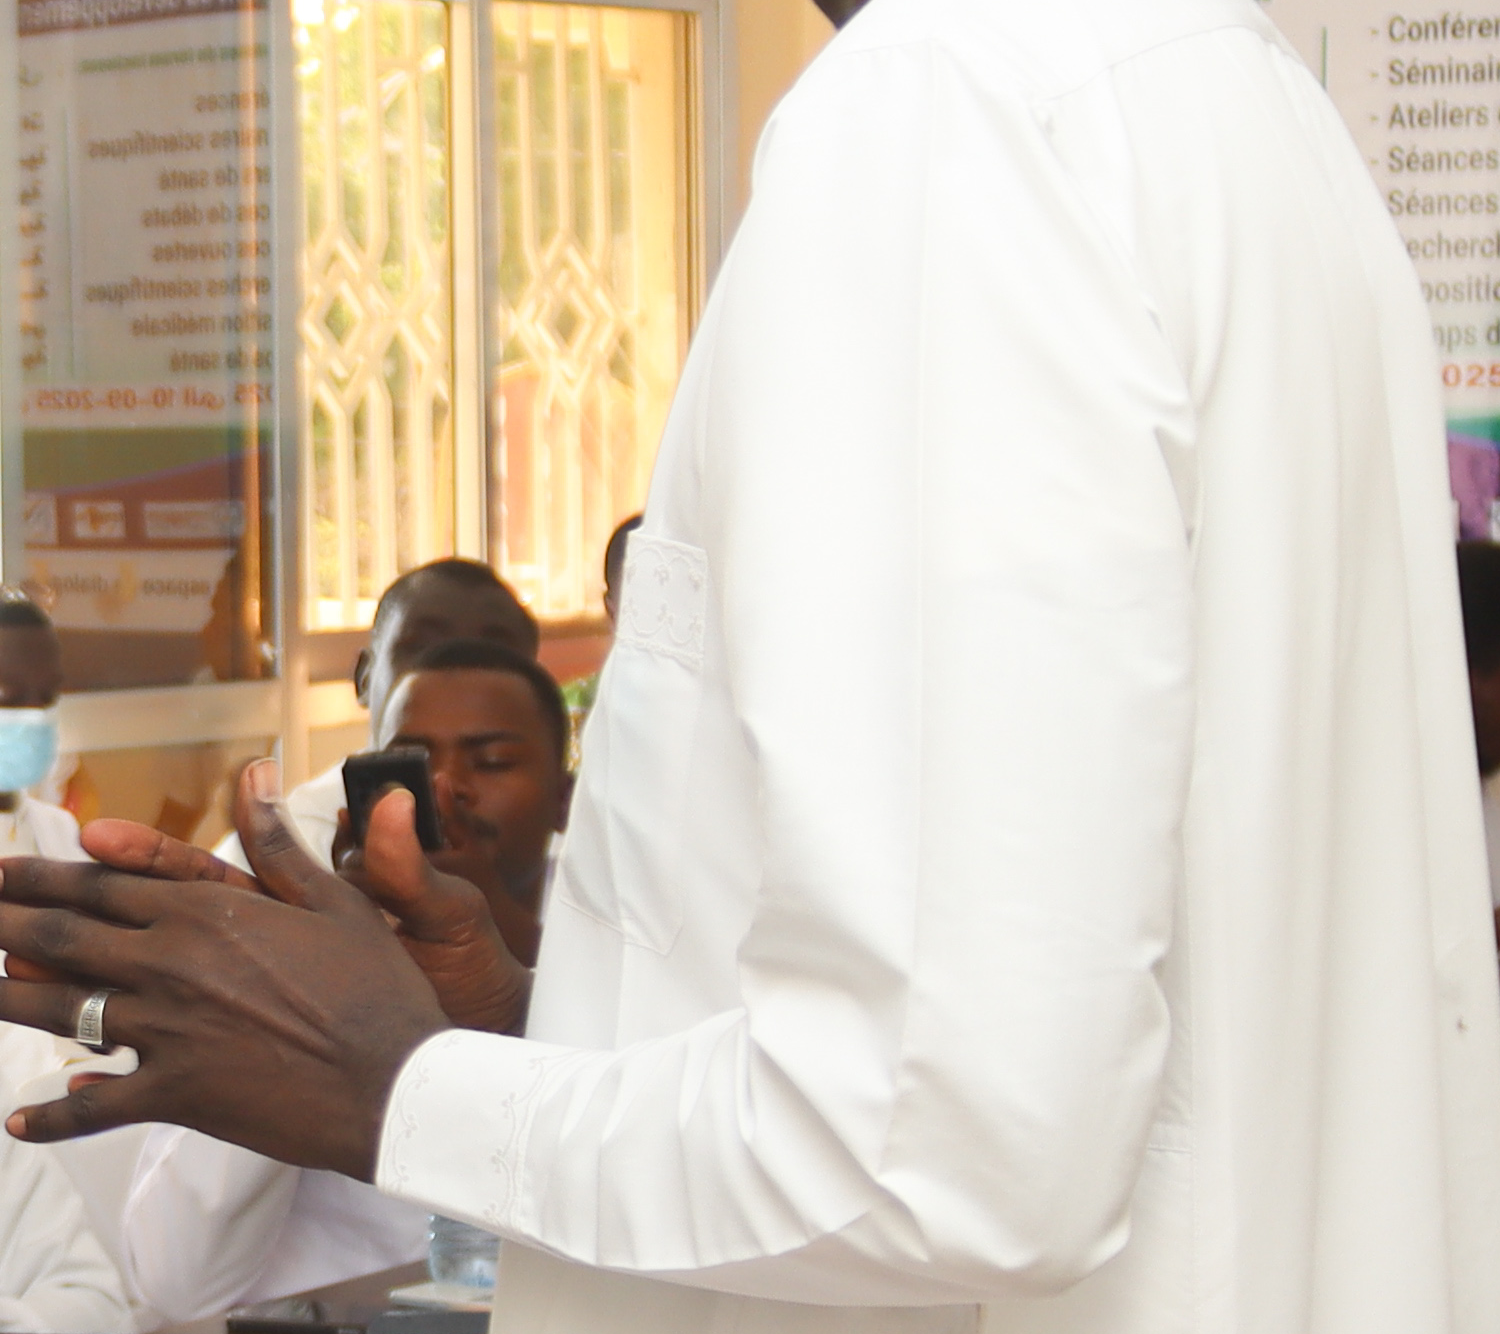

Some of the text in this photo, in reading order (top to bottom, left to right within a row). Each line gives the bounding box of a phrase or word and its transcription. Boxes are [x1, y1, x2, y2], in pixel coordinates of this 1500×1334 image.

[1387, 99, 1490, 131] Ateliers
[1387, 144, 1499, 174] Séances
[1387, 187, 1499, 217] Séances
